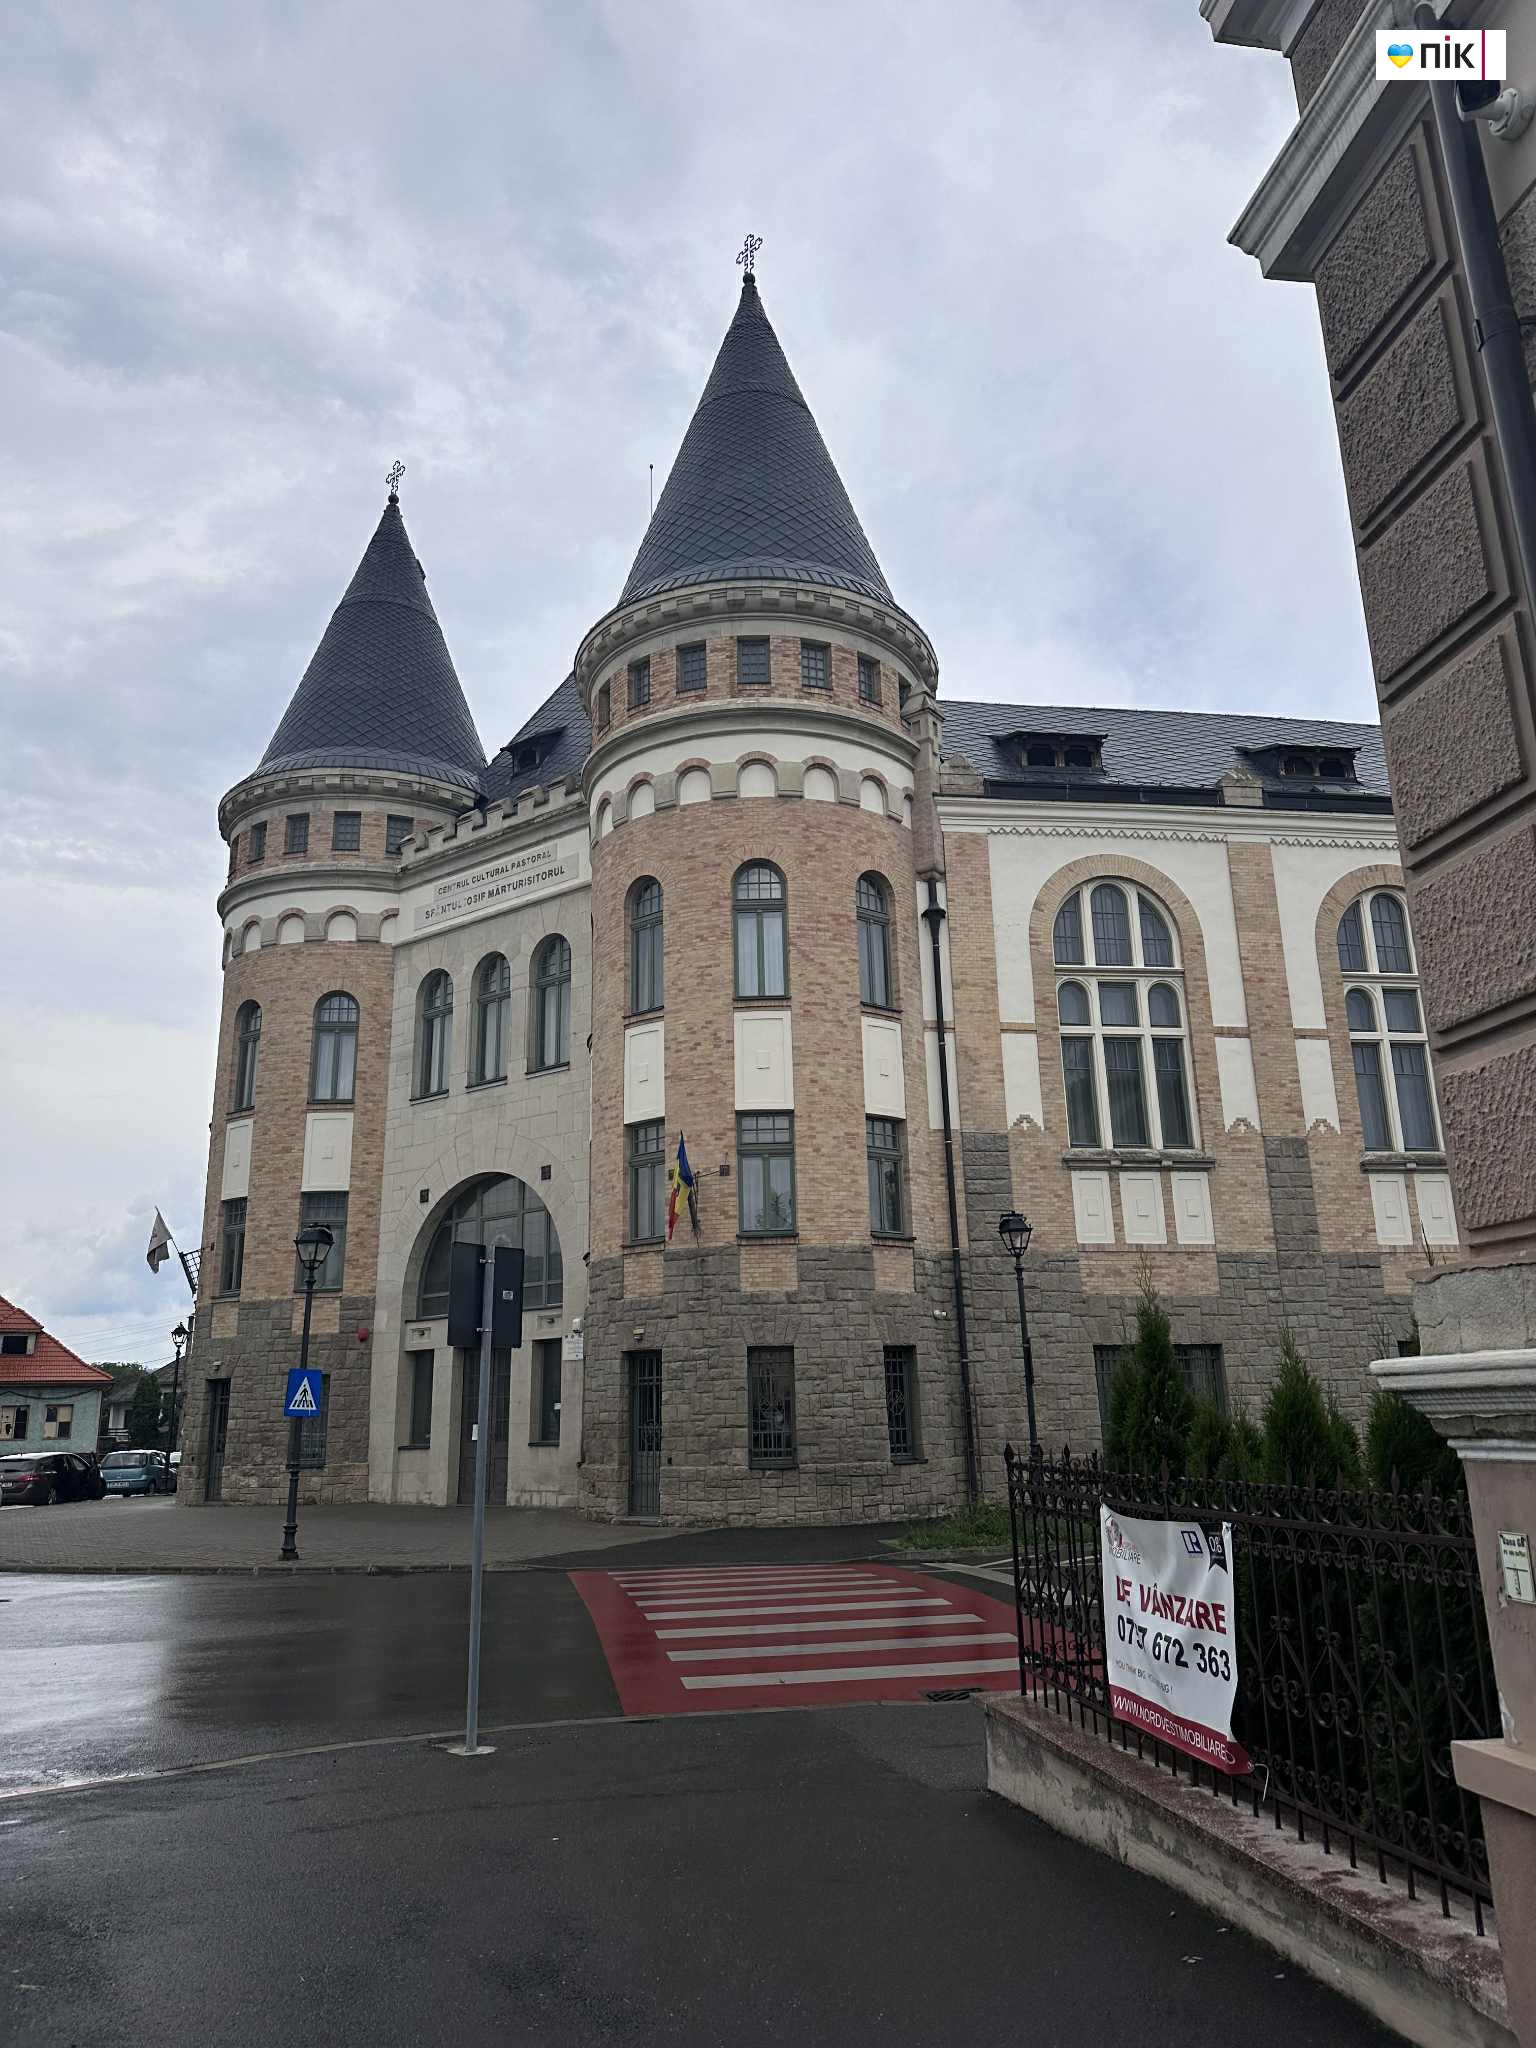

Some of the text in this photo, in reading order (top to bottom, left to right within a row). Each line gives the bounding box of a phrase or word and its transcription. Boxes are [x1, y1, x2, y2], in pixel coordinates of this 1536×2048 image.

[471, 865, 510, 884] CULTURAL
[511, 850, 552, 871] PASTORAL
[1139, 1583, 1227, 1634] VÂNZARE
[1152, 1631, 1190, 1669] 672
[1193, 1642, 1231, 1682] 363
